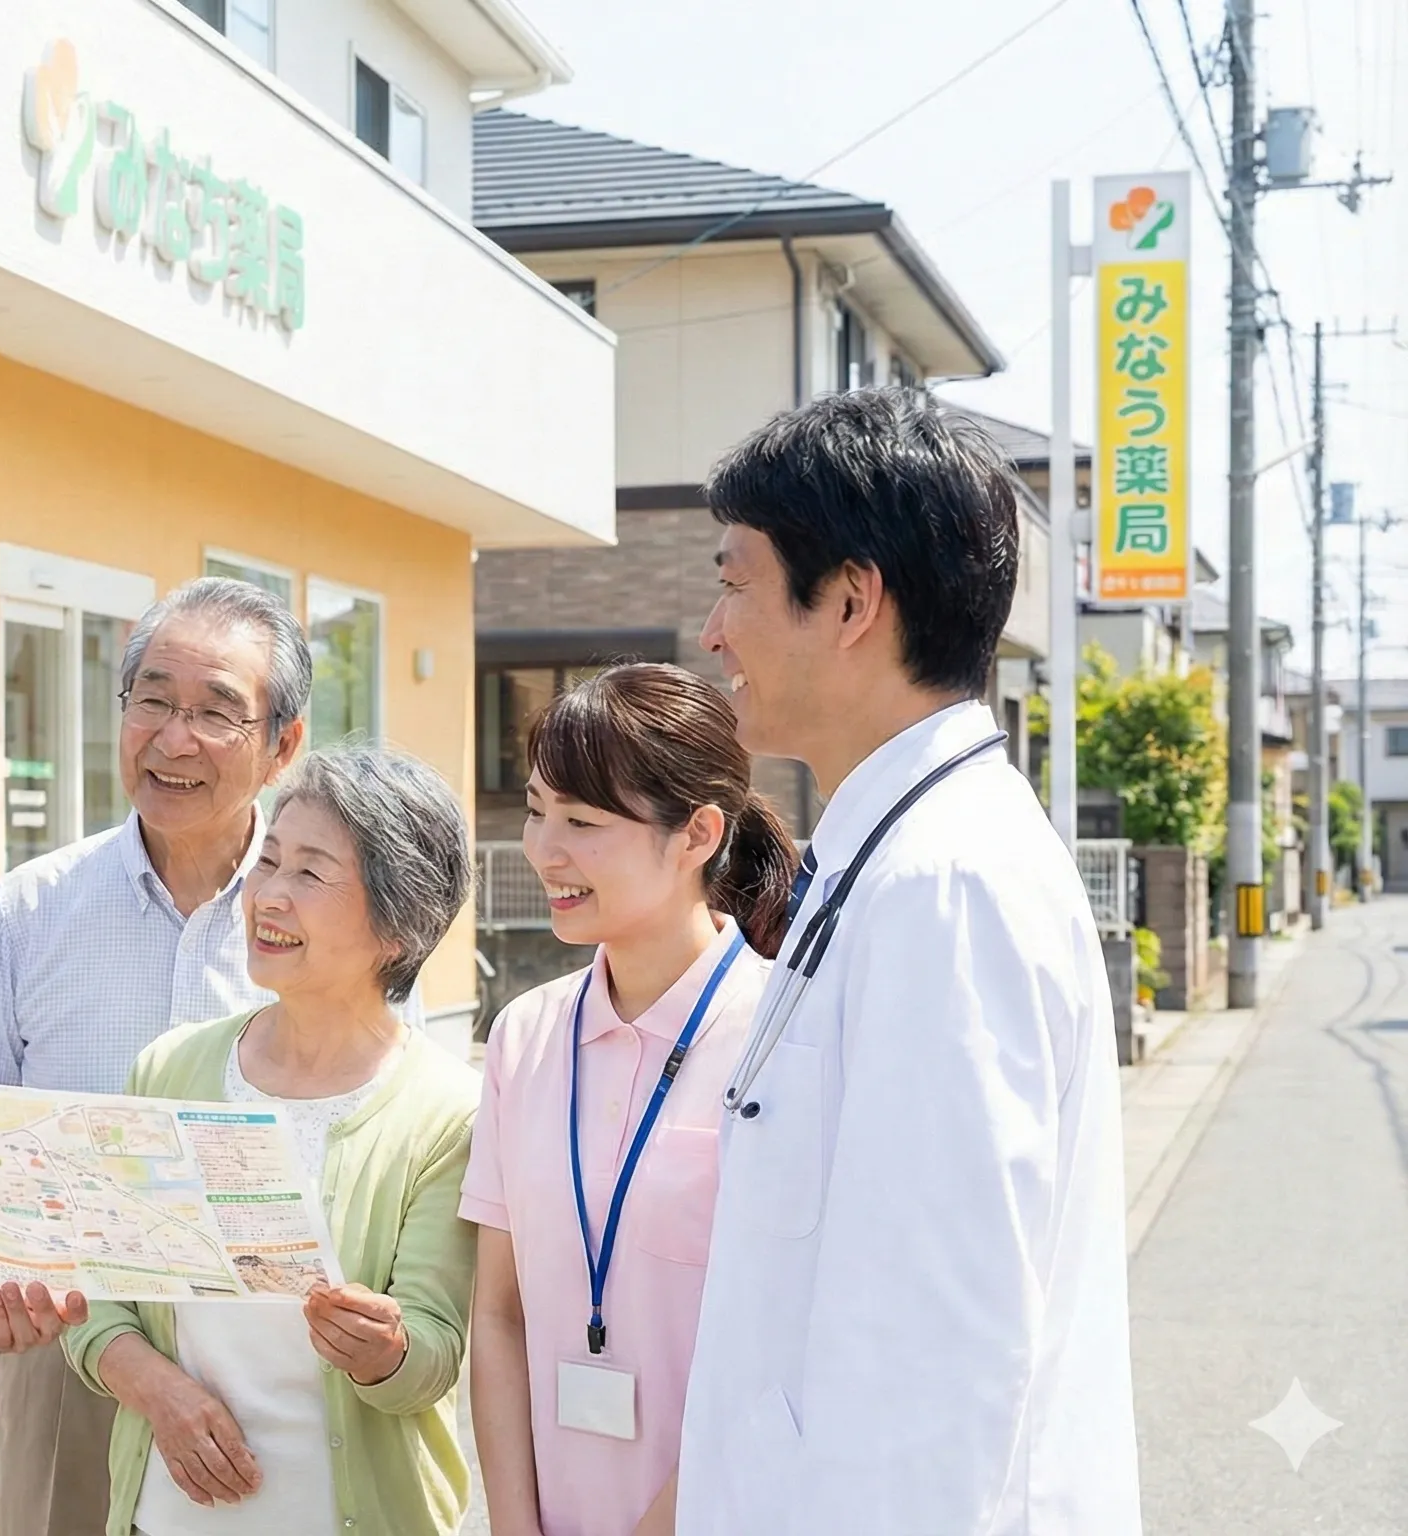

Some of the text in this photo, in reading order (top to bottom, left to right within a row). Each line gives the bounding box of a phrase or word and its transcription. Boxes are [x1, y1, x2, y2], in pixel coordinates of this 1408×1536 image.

[1115, 277, 1169, 554] みなう薬局
